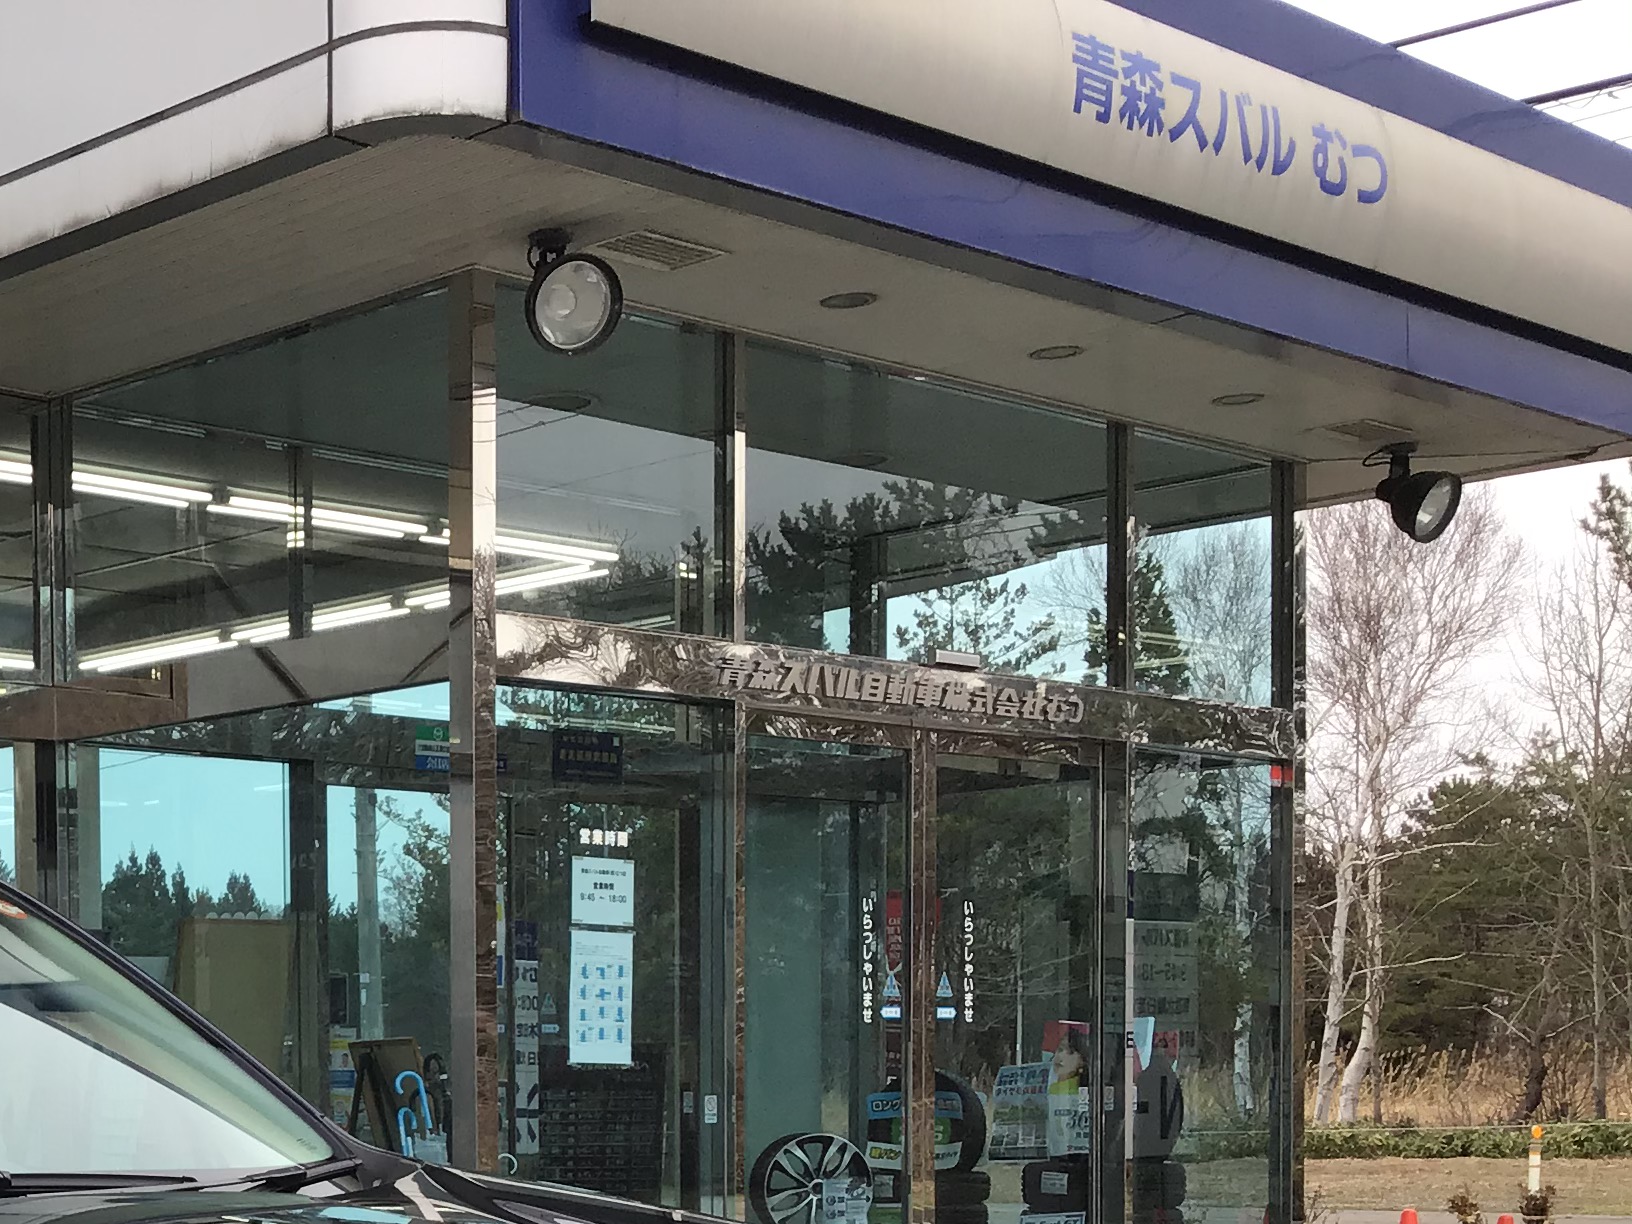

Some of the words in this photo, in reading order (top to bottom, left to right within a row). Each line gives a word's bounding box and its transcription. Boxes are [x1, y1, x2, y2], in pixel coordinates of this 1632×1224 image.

[1071, 31, 1296, 177] 青森スバル
[1312, 122, 1389, 204] むつ
[862, 897, 873, 1023] いらっしゃいませ
[964, 900, 974, 1023] いらっしゃいませ
